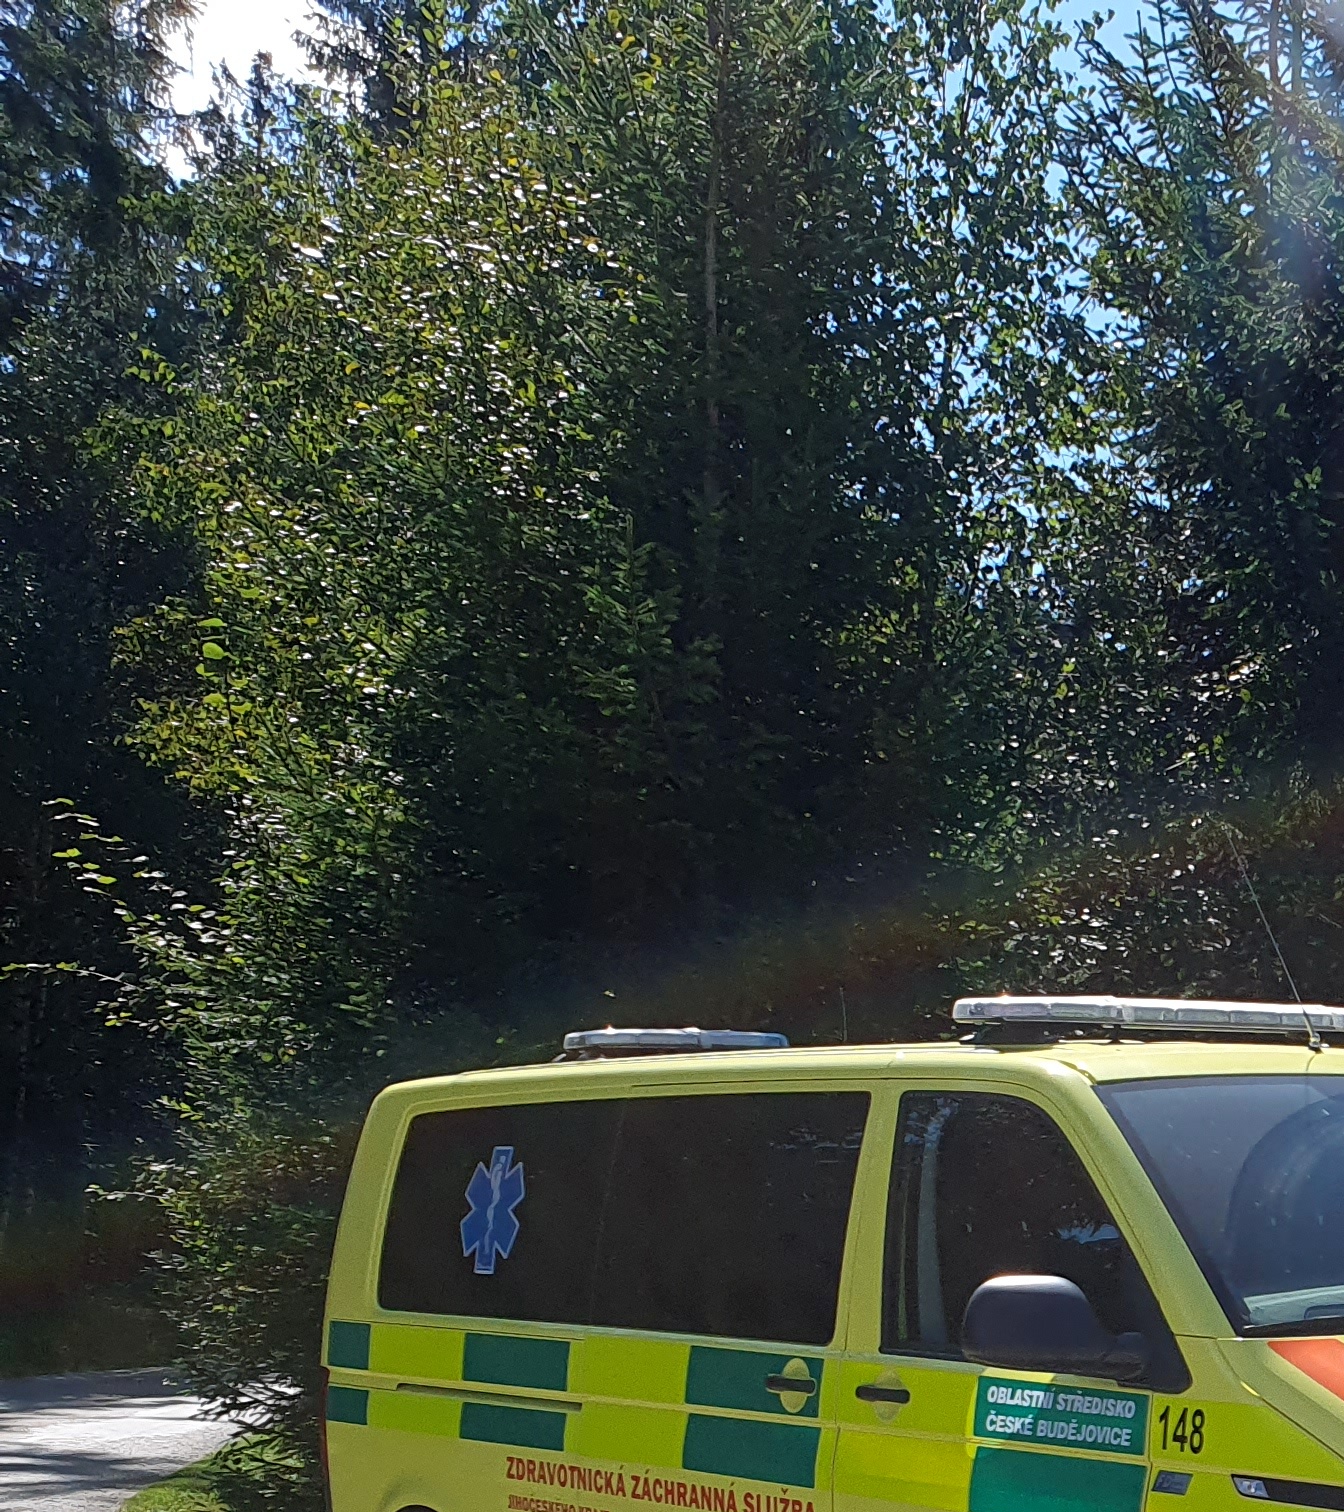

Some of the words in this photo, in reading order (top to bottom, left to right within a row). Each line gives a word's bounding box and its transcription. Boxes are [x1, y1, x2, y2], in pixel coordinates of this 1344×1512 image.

[986, 1385, 1056, 1410] OBLASTNÍ
[1056, 1390, 1136, 1419] STŘEDISKO
[986, 1409, 1034, 1436] ČESKÉ
[1036, 1418, 1133, 1447] BUDĚJOVICE
[1159, 1405, 1206, 1454] 148
[506, 1456, 627, 1498] ZDRAVOTNICKÁ
